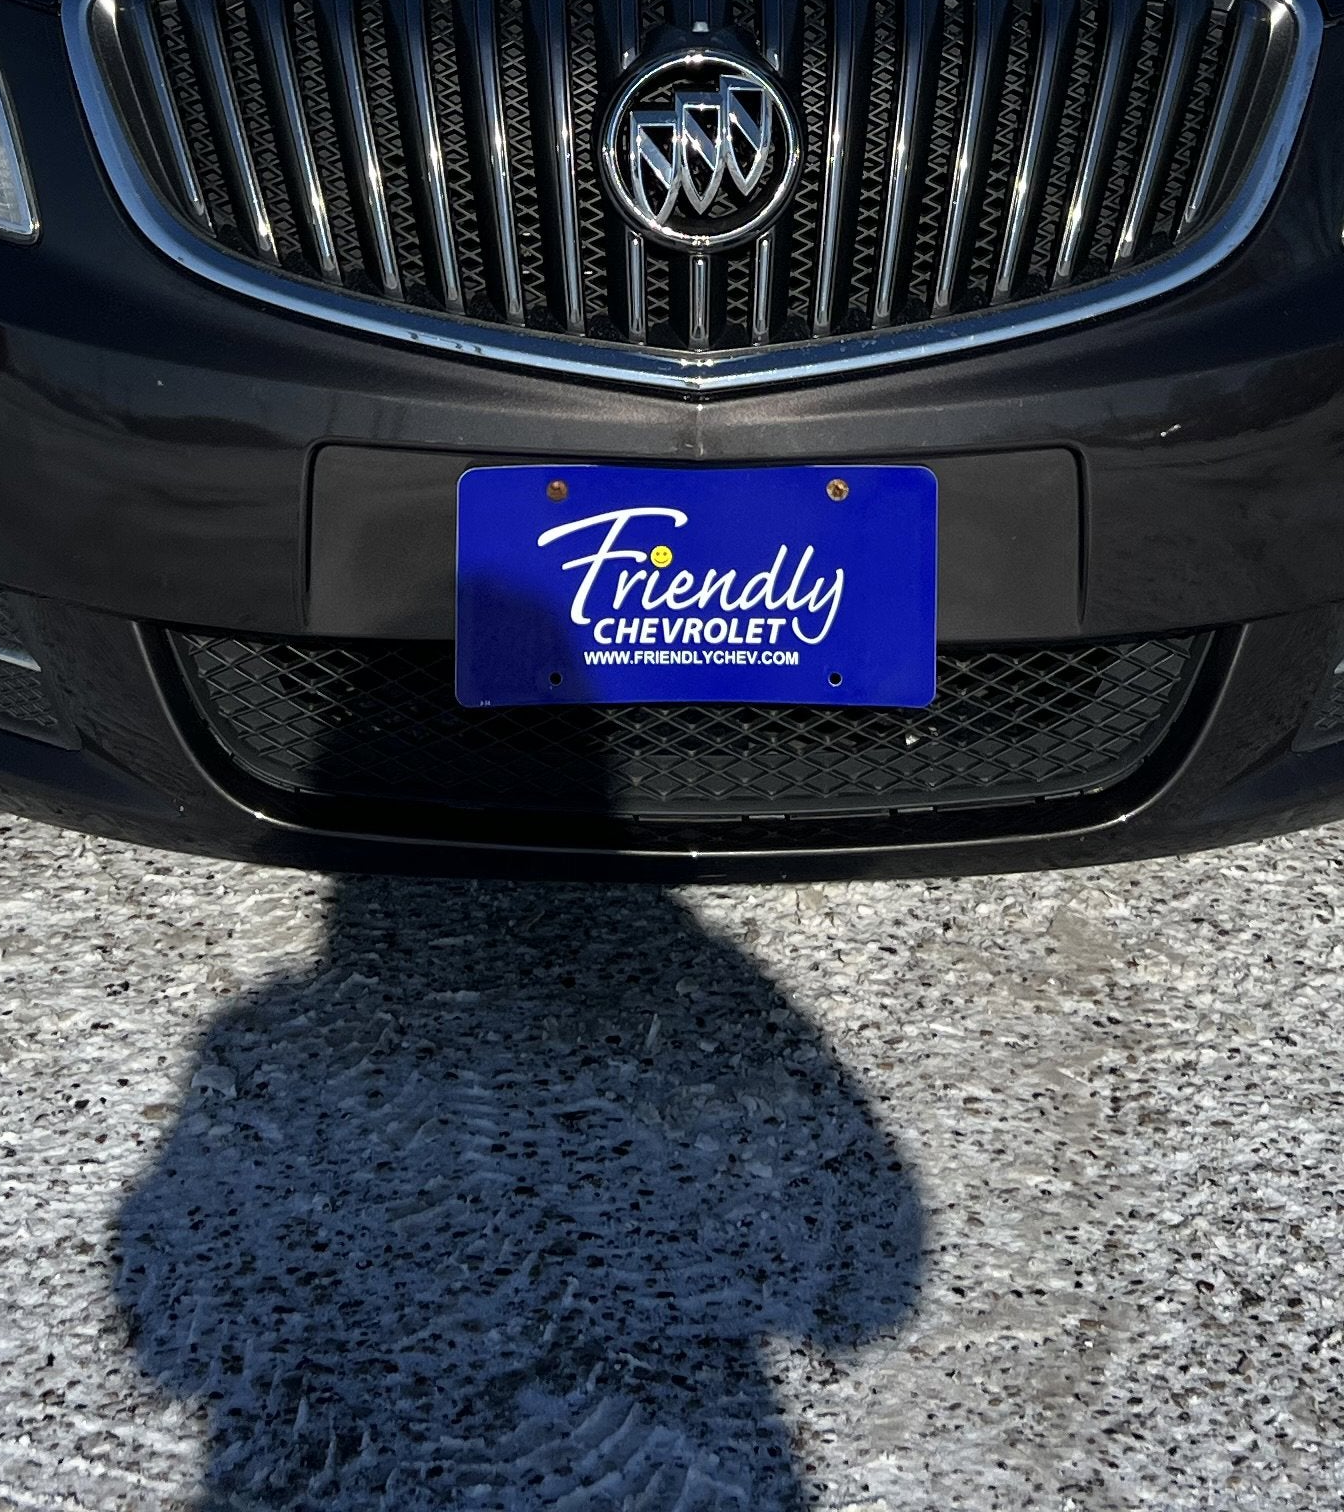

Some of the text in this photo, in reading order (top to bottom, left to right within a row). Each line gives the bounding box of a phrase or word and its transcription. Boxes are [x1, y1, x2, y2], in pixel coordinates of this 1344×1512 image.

[536, 505, 845, 644] Friendly
[592, 616, 787, 645] CHEVROLET
[582, 649, 800, 666] WWW.FRIENDLYCHEV.COM
